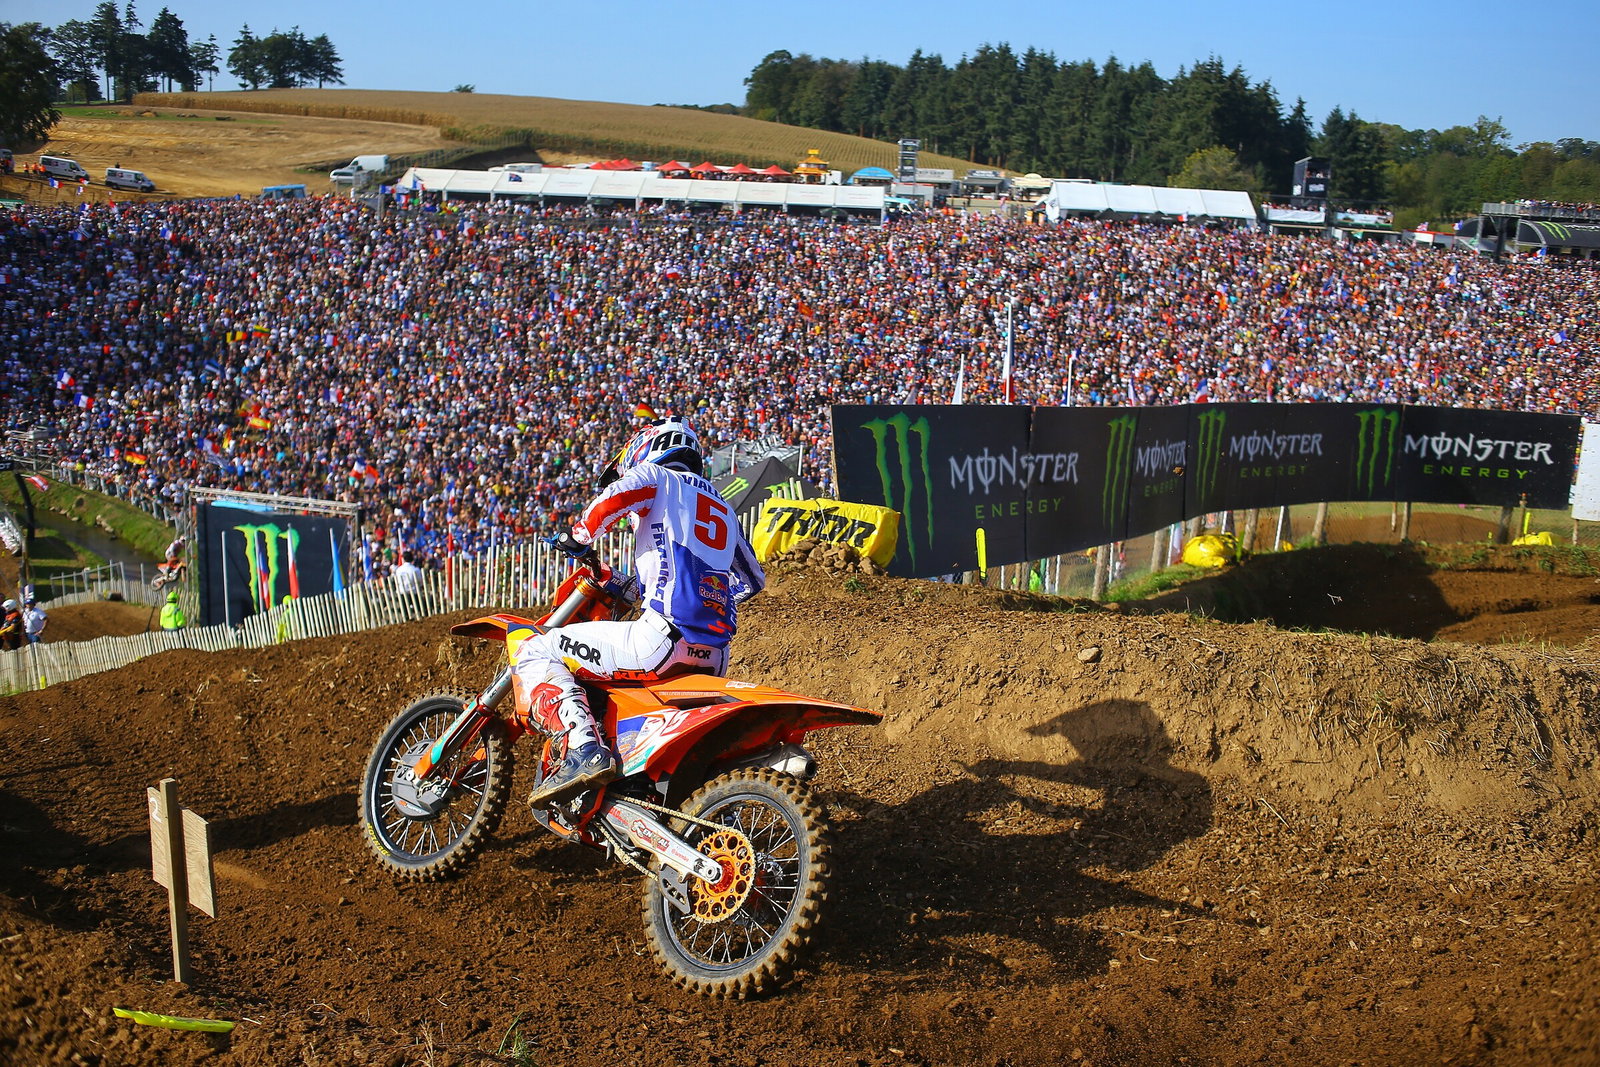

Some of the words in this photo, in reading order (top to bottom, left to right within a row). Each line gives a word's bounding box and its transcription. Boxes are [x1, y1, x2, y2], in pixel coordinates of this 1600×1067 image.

[1135, 438, 1187, 478] MONSTER
[1229, 429, 1324, 462] MONSTER
[1404, 431, 1555, 465] MONSTER
[948, 446, 1079, 495] MONSTER
[1422, 464, 1530, 480] ENERGY
[693, 491, 729, 551] 5
[975, 498, 1063, 520] ENERGY
[766, 506, 877, 549] THOR
[559, 634, 601, 666] THOR
[686, 646, 712, 660] THOR
[612, 668, 659, 681] KTM
